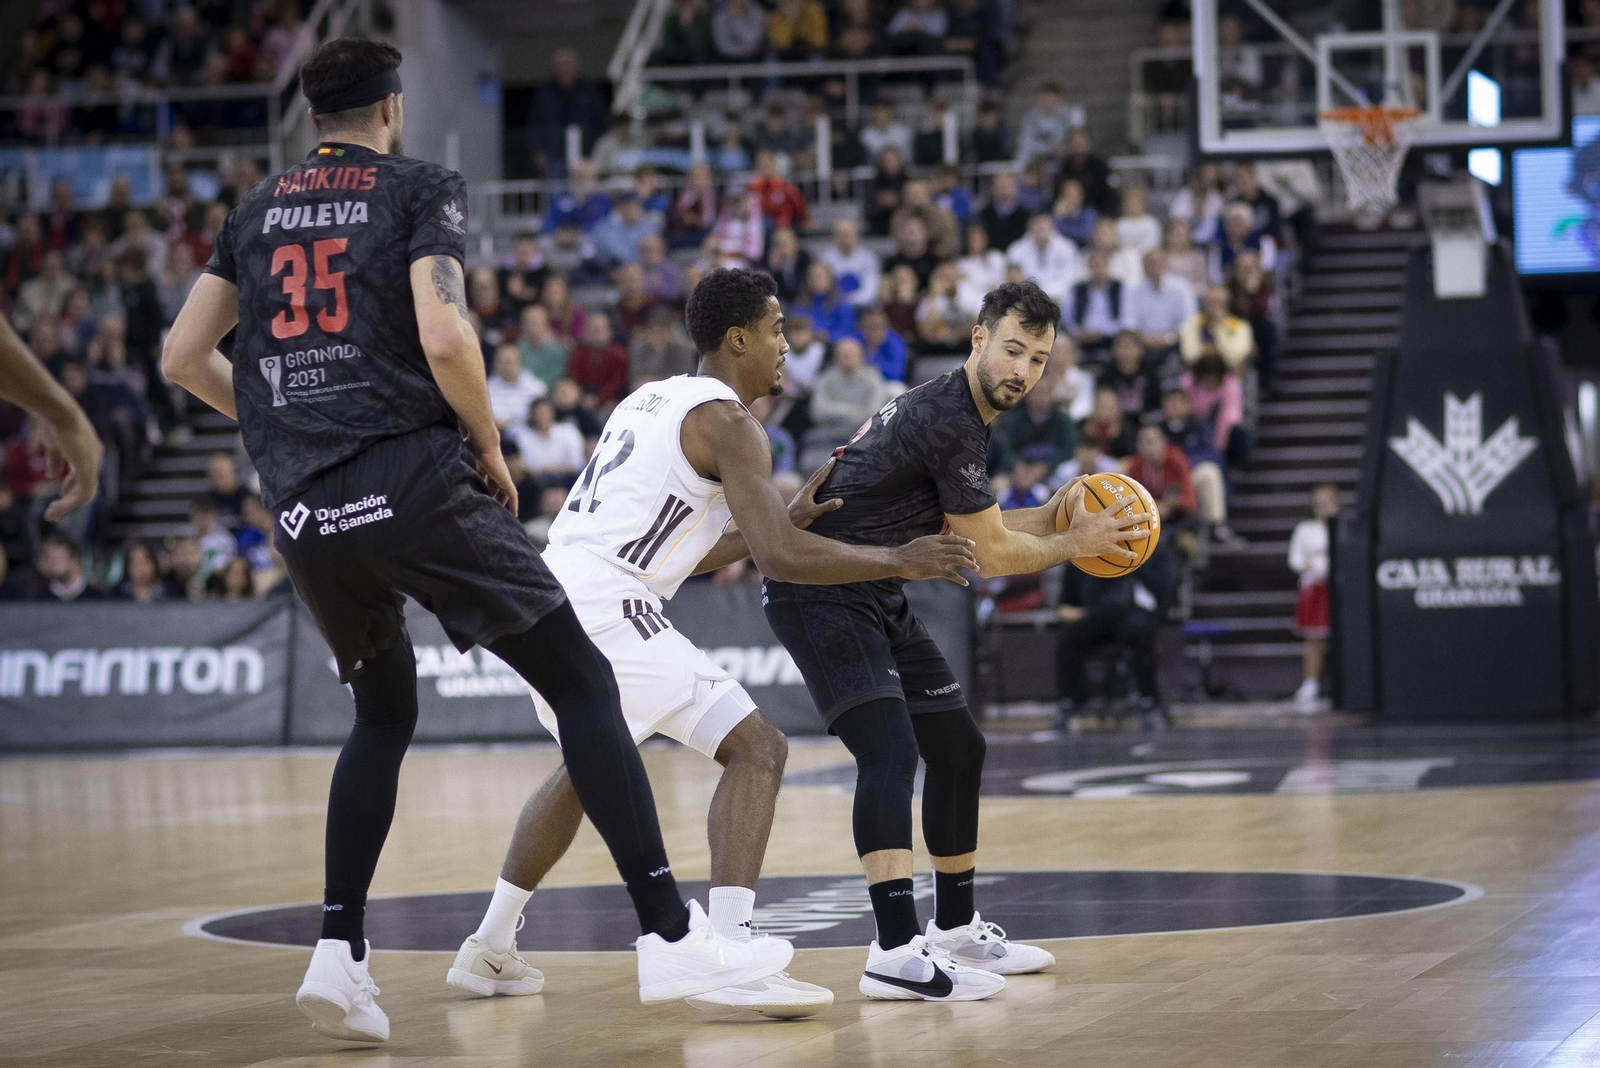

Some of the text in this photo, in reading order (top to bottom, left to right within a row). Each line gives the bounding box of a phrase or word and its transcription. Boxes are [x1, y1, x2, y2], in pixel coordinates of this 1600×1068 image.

[262, 201, 368, 234] PULEVA
[270, 238, 348, 340] 35
[287, 368, 326, 388] 2031
[319, 522, 338, 536] de
[0, 647, 265, 697] INFINITON
